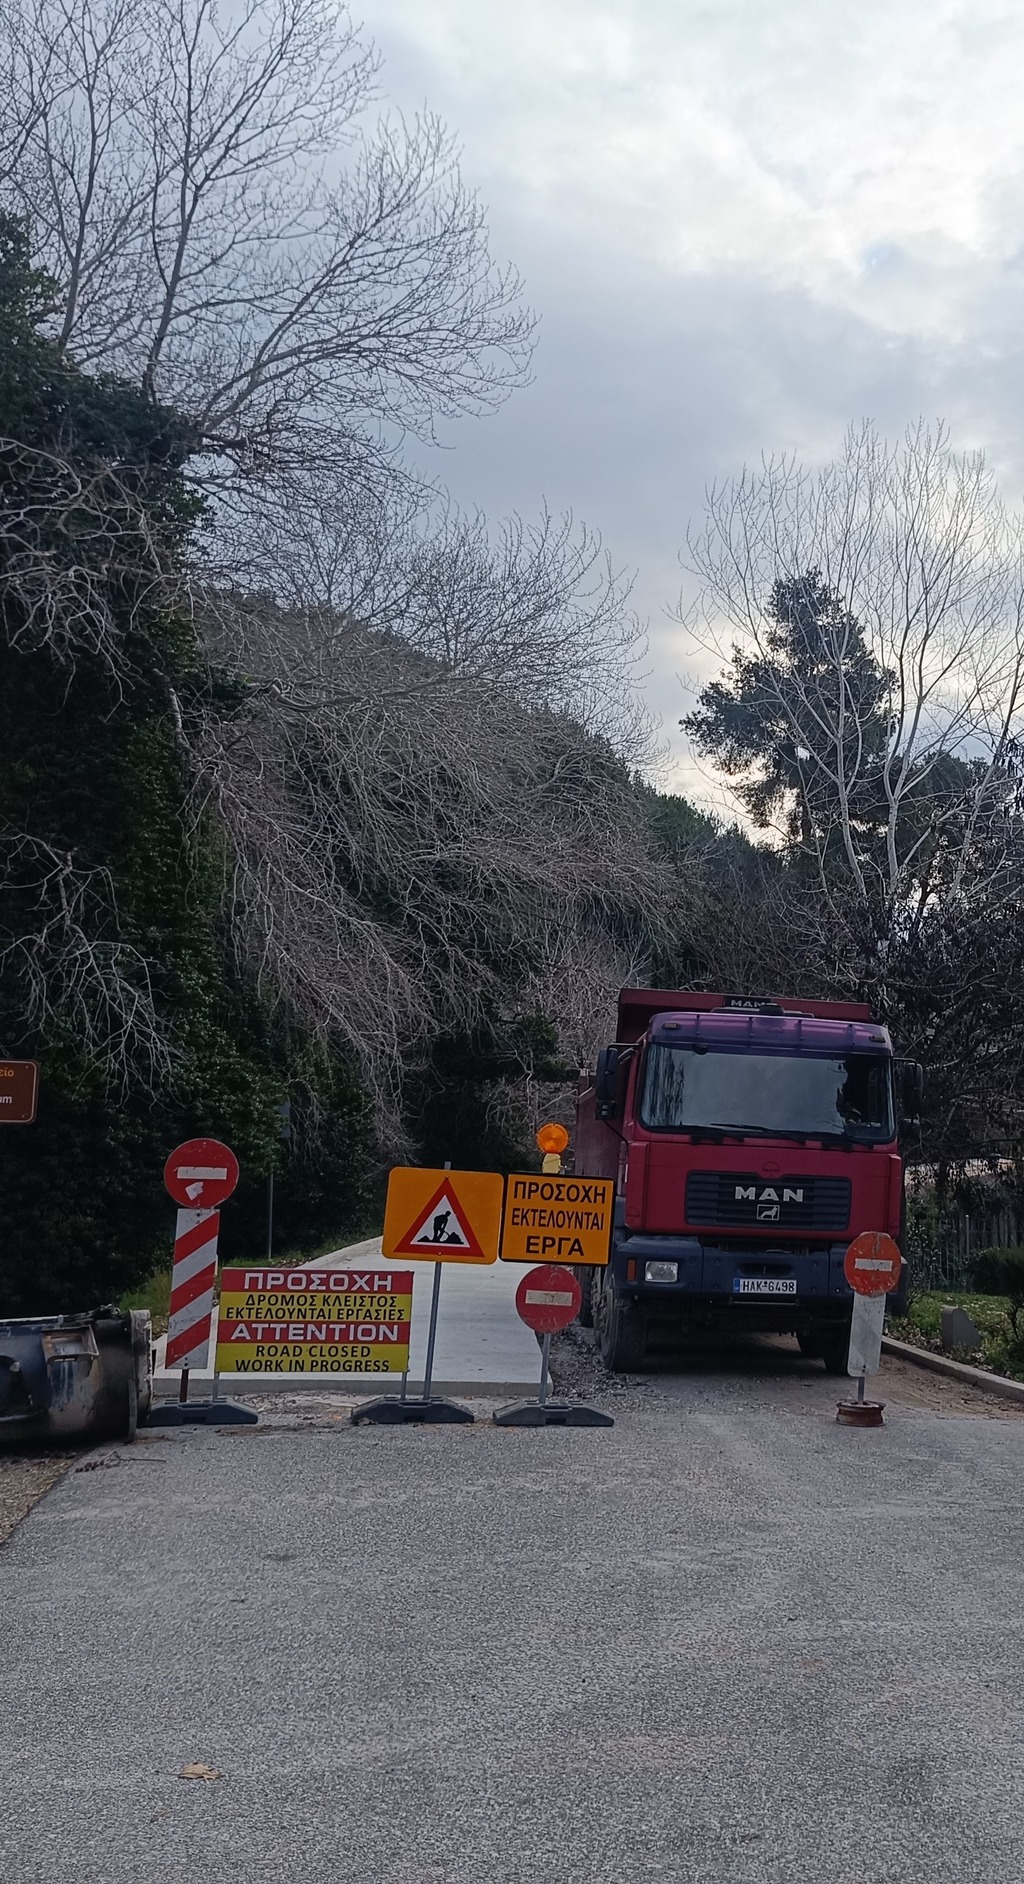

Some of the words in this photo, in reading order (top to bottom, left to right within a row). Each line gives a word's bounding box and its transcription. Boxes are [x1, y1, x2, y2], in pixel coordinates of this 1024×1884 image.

[513, 1181, 606, 1204] ΠΡΟΣΟΧΗ
[734, 1186, 804, 1202] MAN
[511, 1207, 605, 1231] ΕΚΤΕΛΟΥΝΤΑΙ
[525, 1235, 585, 1256] ΕΡΓΑ
[244, 1272, 392, 1292] ΠΡΟΣΟΧΗ
[245, 1294, 318, 1307] ΔΡΟΜΟΣ
[322, 1294, 398, 1308] ΚΛΕΙΣΤΟΣ
[226, 1307, 332, 1320] ΕΚΤΕΛΟΥΝΤΑΙ
[336, 1308, 405, 1321] ΕΡΓΑΣΙΕΣ
[230, 1323, 398, 1341] ATTENTION
[255, 1345, 301, 1357] ROAD
[308, 1345, 371, 1358] CLOSED
[235, 1359, 284, 1372] WORK
[288, 1359, 305, 1372] IN
[310, 1359, 390, 1372] PROGRESS
